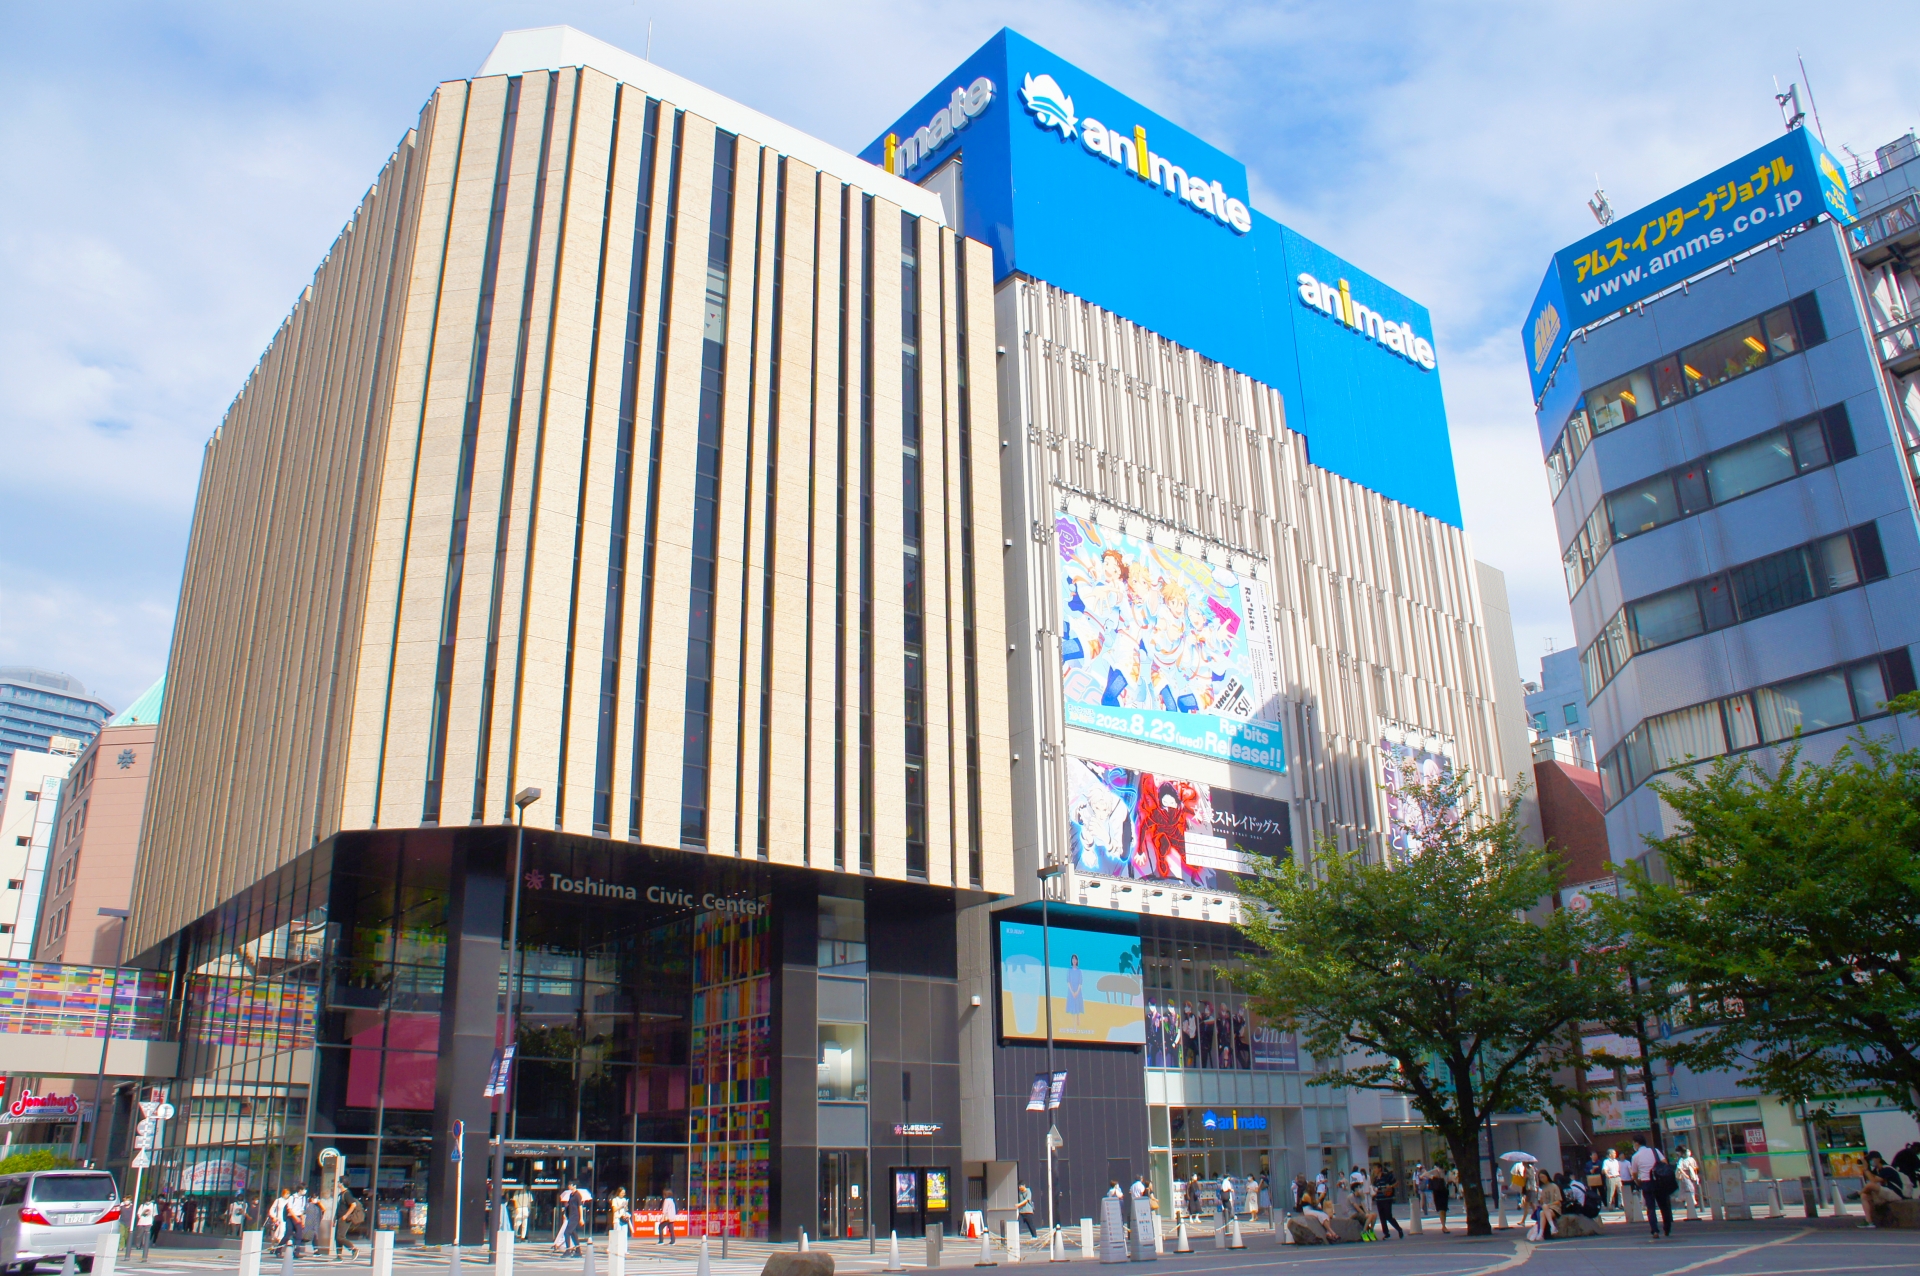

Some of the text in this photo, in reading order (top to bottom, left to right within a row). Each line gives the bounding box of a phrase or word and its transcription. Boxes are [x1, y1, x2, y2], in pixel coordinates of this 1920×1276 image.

[880, 76, 997, 179] imate
[1081, 124, 1252, 235] animate
[1572, 156, 1794, 283] アムス・インターナショナル
[1581, 188, 1803, 306] www.amms.co.jp
[1297, 273, 1436, 372] animate
[1205, 732, 1282, 767] Release!!
[550, 873, 766, 915] Toshima Civic Center
[1218, 1109, 1267, 1131] animate
